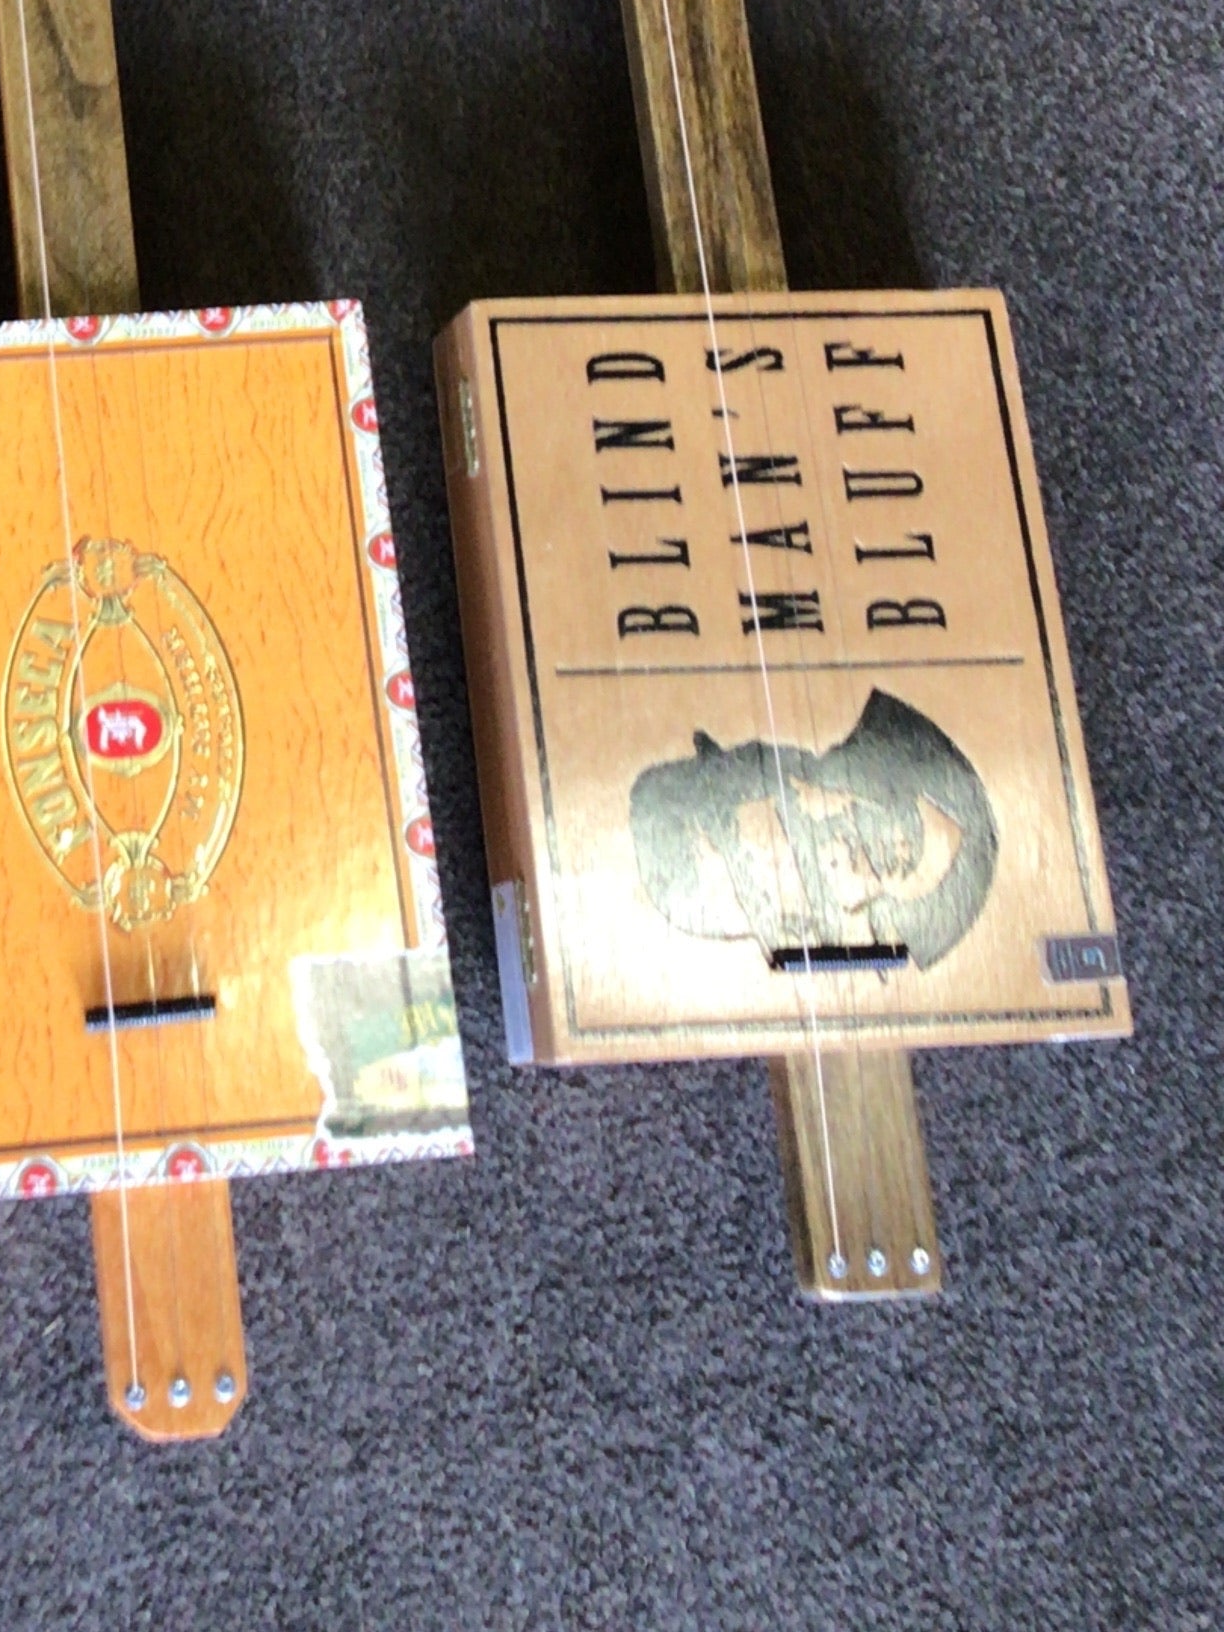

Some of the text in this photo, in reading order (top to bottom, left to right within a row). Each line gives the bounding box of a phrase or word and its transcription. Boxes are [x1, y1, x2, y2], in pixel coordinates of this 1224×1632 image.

[586, 352, 700, 640] BLIND
[704, 346, 825, 636] MAN'S
[823, 340, 947, 631] BLUFF
[13, 616, 93, 860] FONSECA
